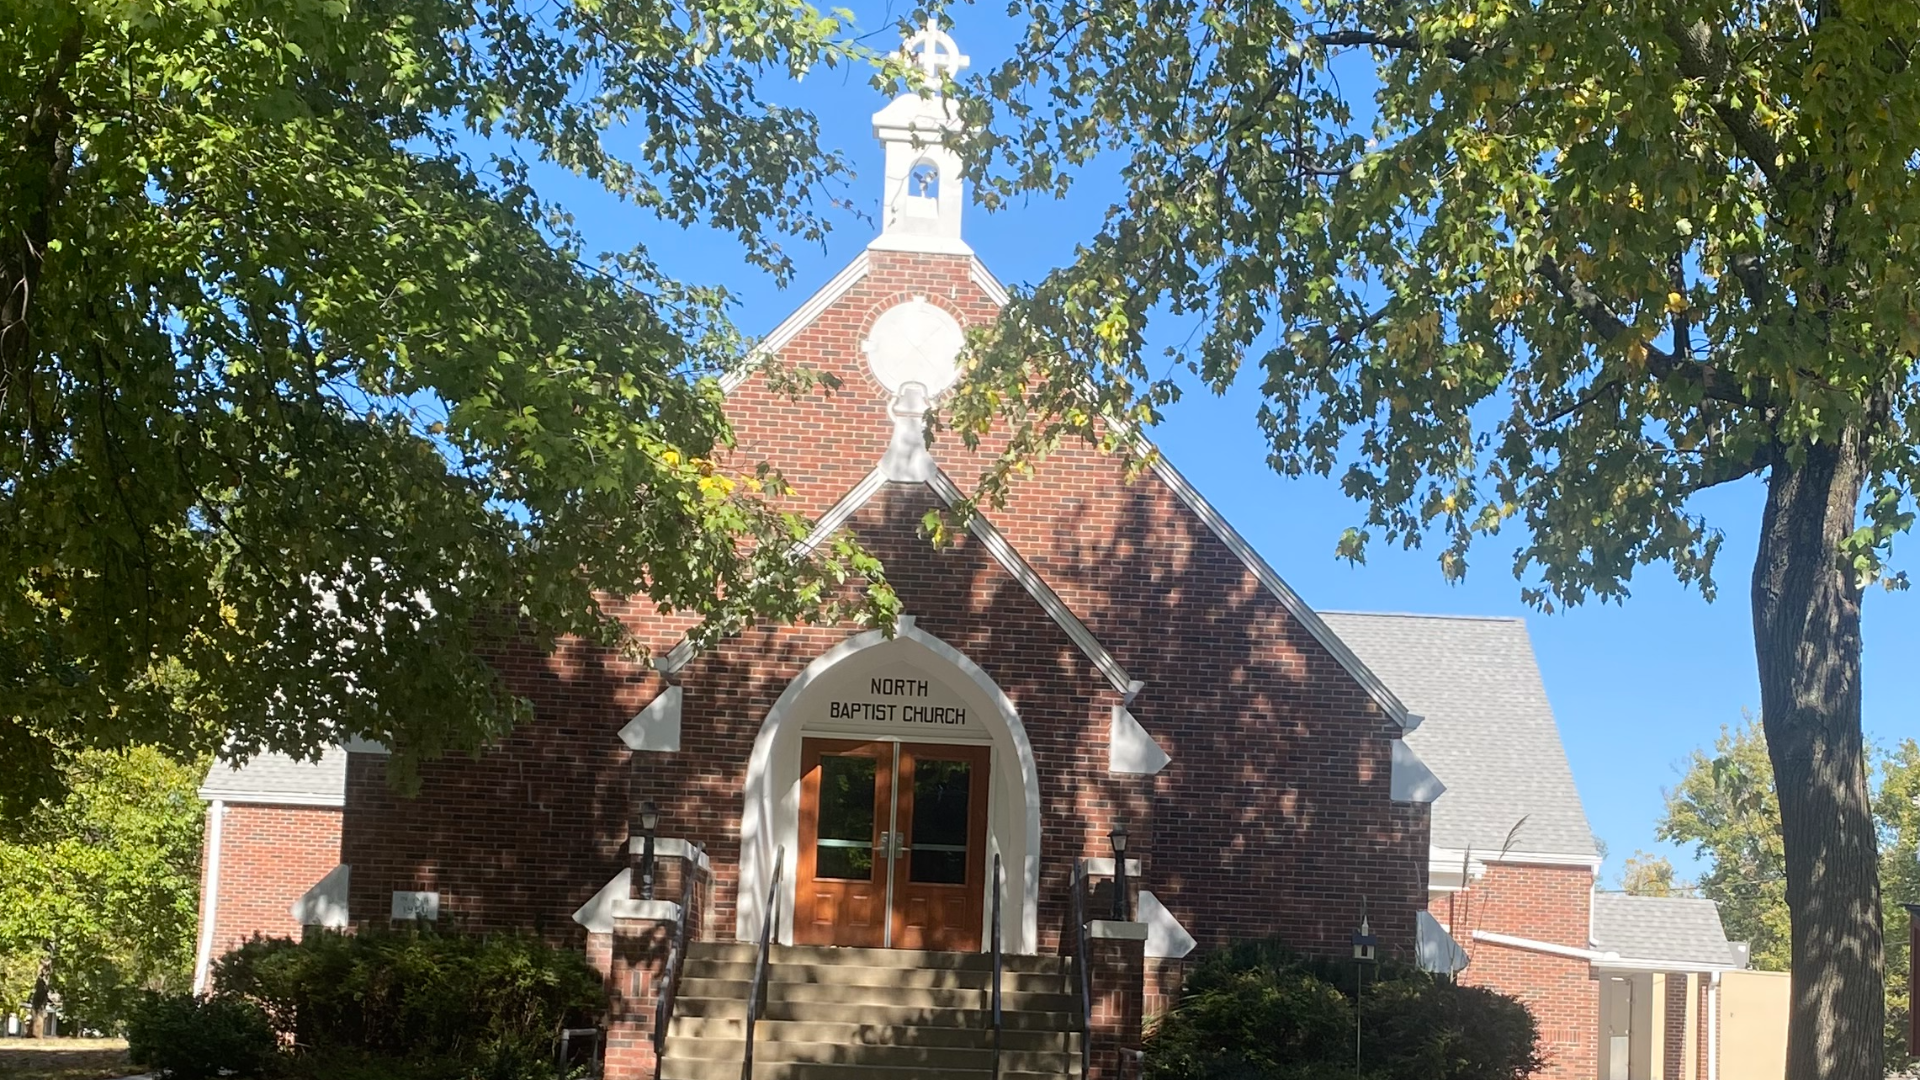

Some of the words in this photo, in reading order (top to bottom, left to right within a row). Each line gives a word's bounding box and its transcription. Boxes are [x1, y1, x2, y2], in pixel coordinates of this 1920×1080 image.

[871, 678, 928, 697] NORTH
[830, 702, 897, 721] BAPTIST
[903, 706, 966, 725] CHURCH
